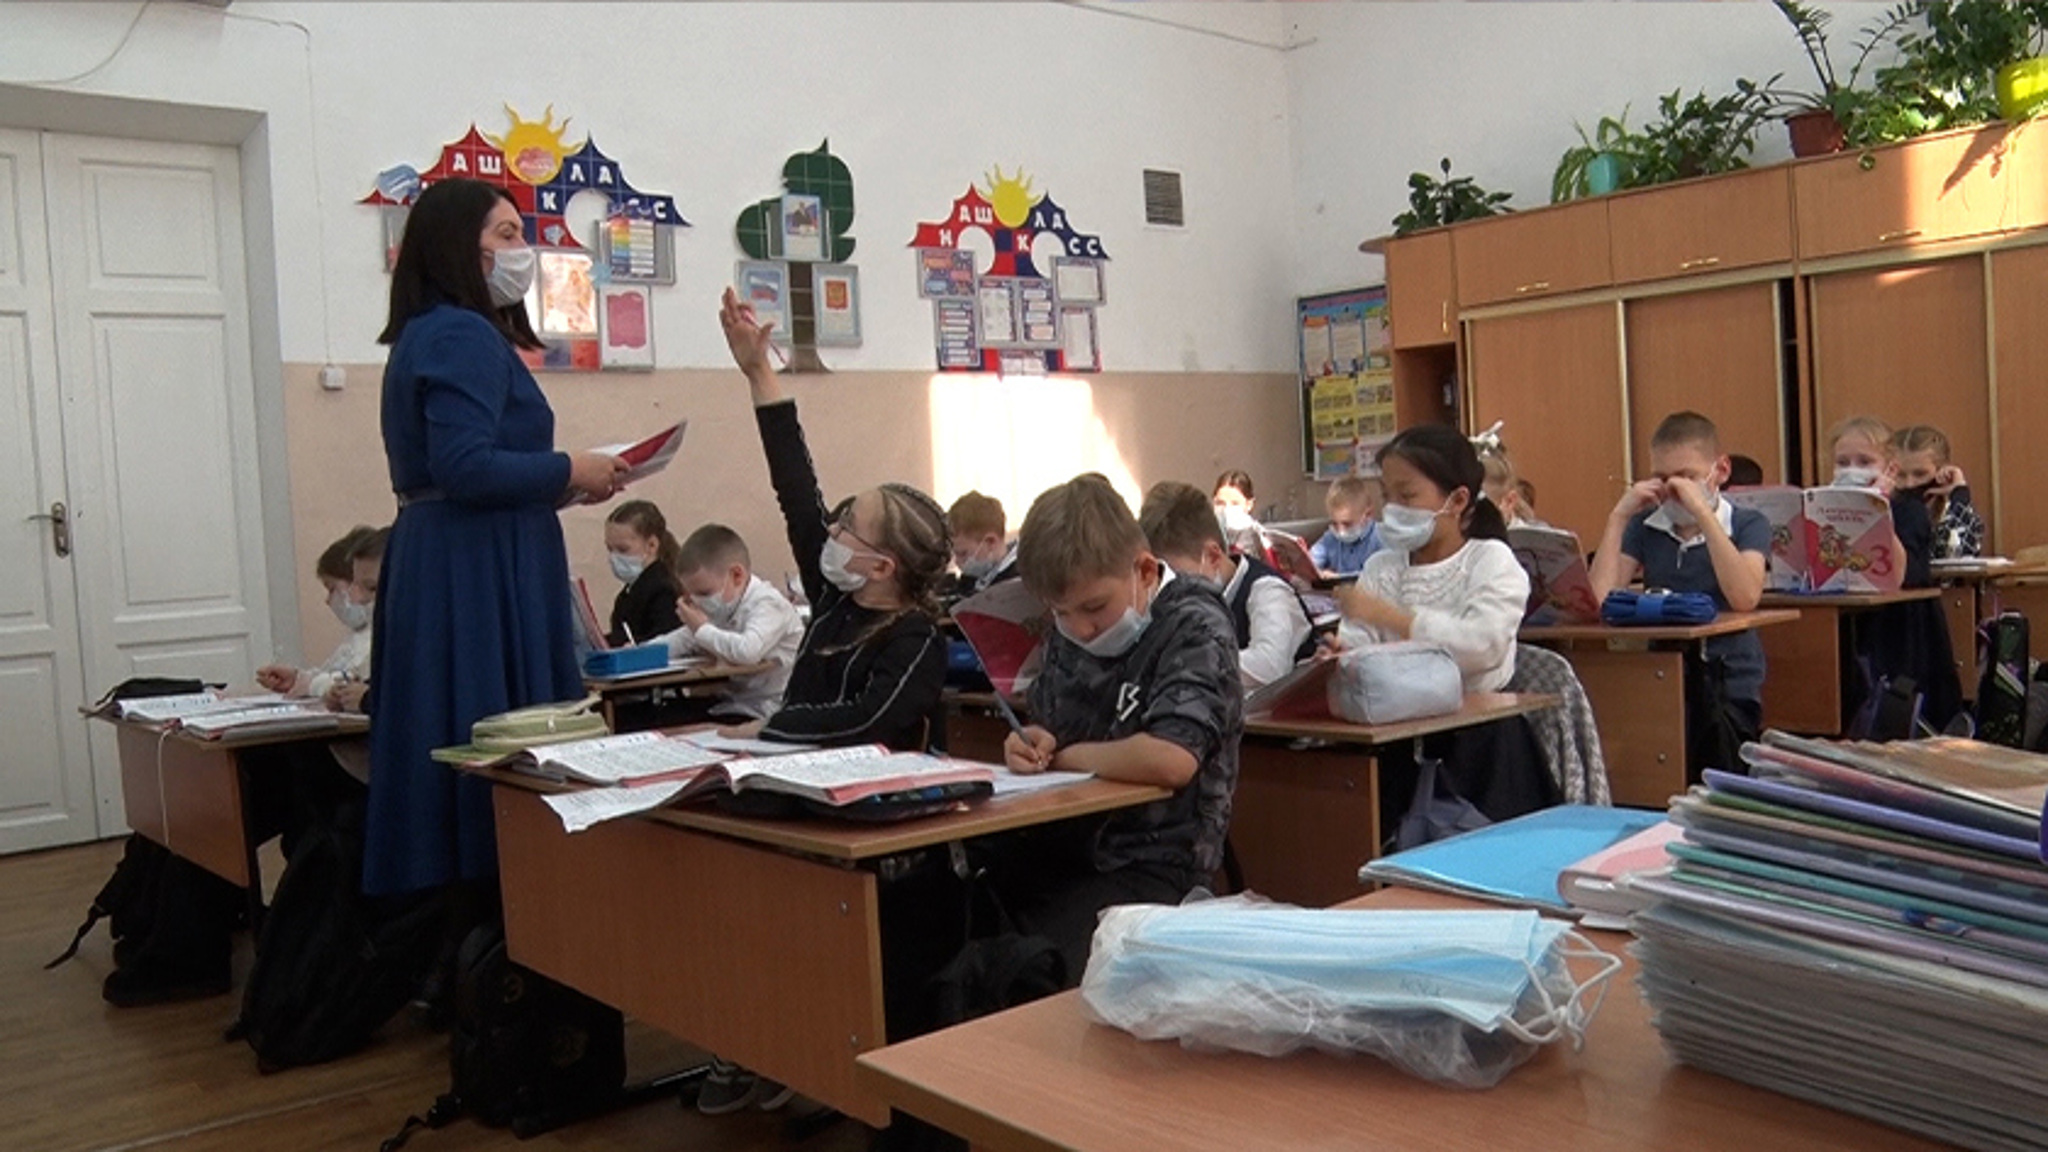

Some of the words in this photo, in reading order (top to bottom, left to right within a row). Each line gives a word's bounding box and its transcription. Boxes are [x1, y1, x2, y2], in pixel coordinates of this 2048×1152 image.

[939, 204, 993, 247] НАШ
[1016, 212, 1099, 255] КЛАСС
[1870, 544, 1893, 576] 3
